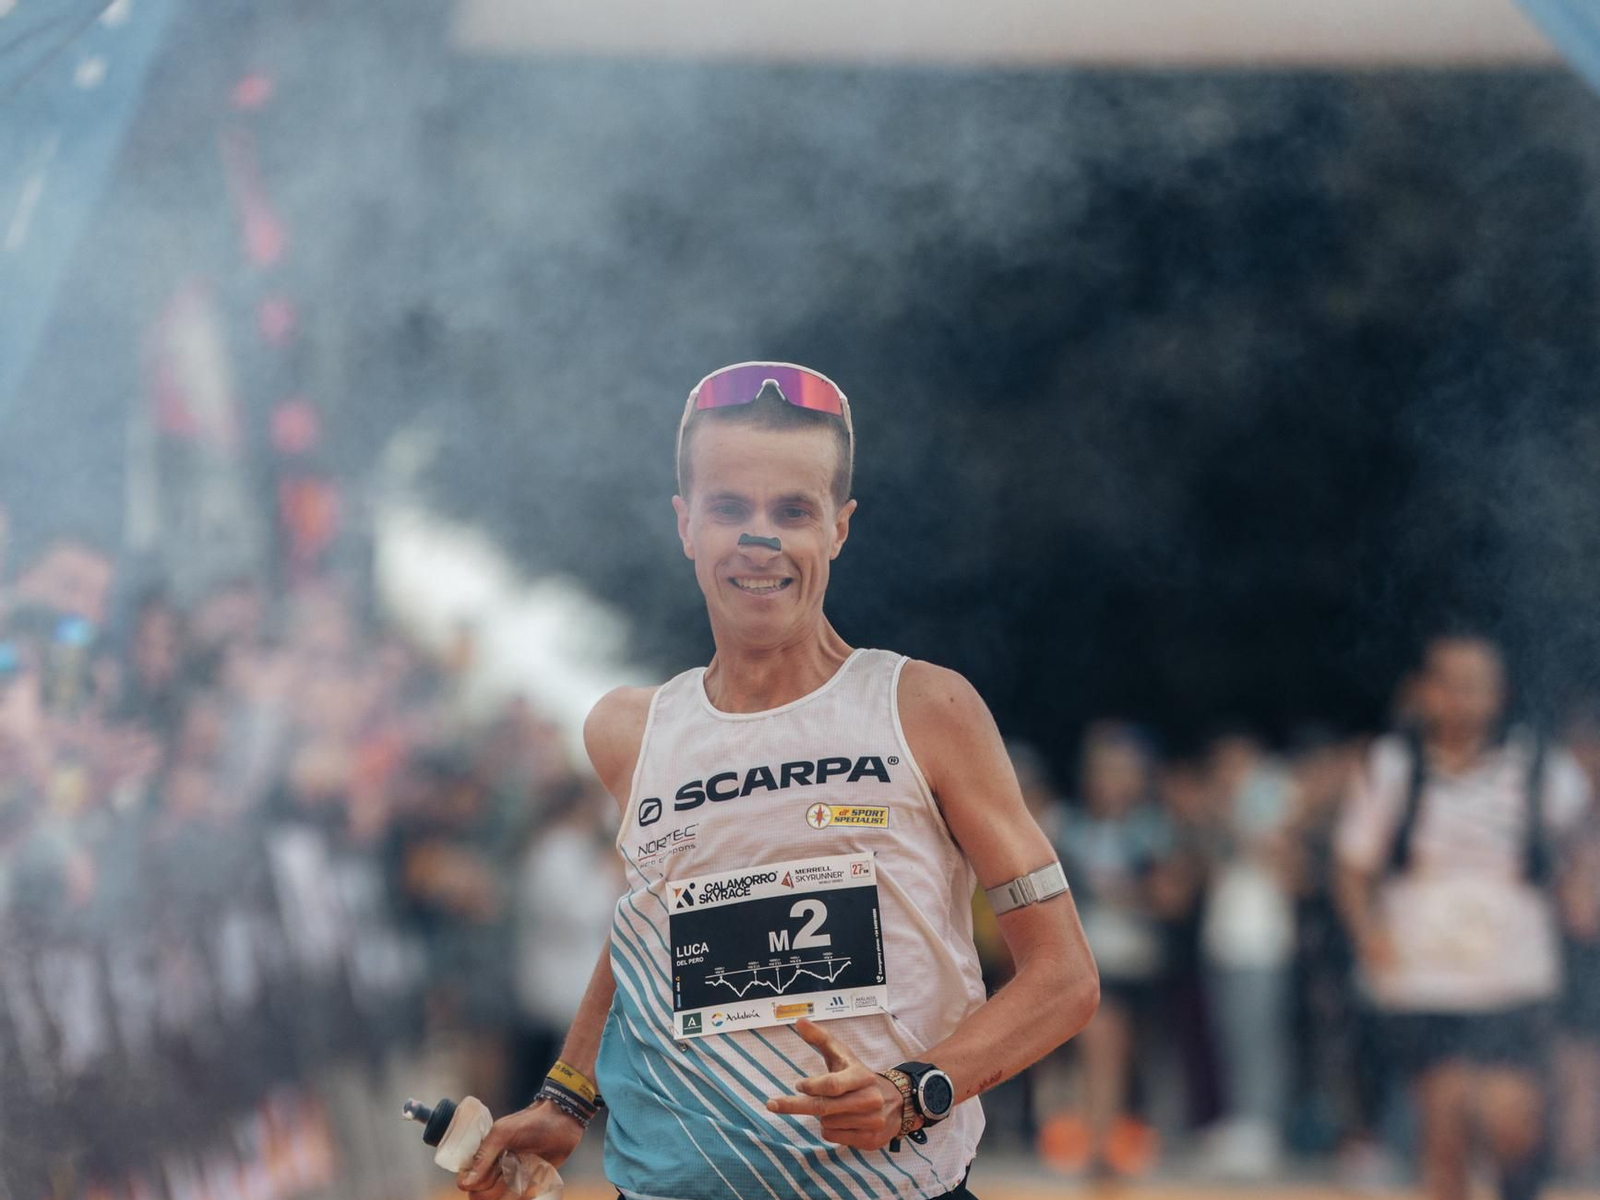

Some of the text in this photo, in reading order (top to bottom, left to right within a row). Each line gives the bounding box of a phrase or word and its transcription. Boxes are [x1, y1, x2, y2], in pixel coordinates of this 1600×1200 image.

[834, 816, 884, 824] SPECIALIST
[852, 809, 886, 817] SPORT
[638, 824, 697, 857] NORTEC
[795, 866, 832, 875] MERRELL
[704, 872, 777, 894] CALAMORRO
[699, 886, 751, 904] SKYRACE
[676, 942, 709, 959] LUCA
[676, 956, 704, 967] DEL PERO
